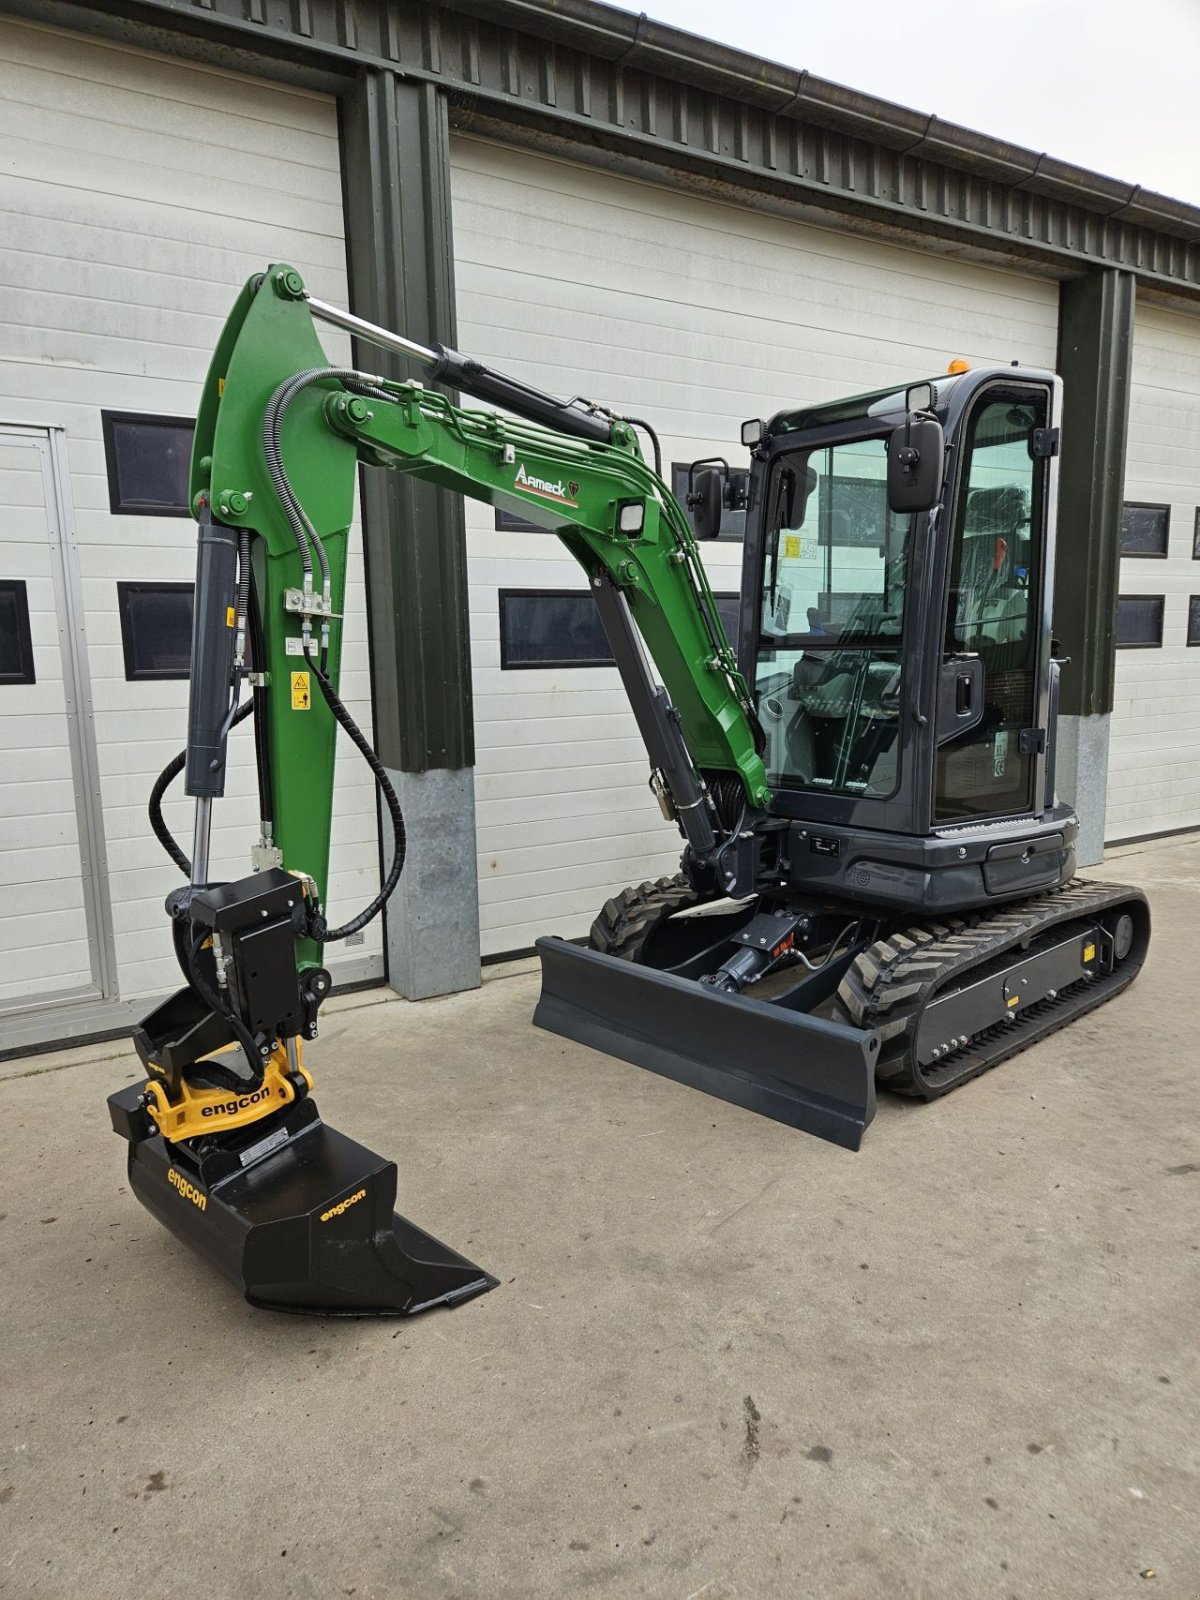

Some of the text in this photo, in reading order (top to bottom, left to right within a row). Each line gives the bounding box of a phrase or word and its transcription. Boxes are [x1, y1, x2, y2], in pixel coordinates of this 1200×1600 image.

[201, 1088, 270, 1118] engcon
[167, 1168, 207, 1211] engcon
[320, 1189, 366, 1222] engcon
